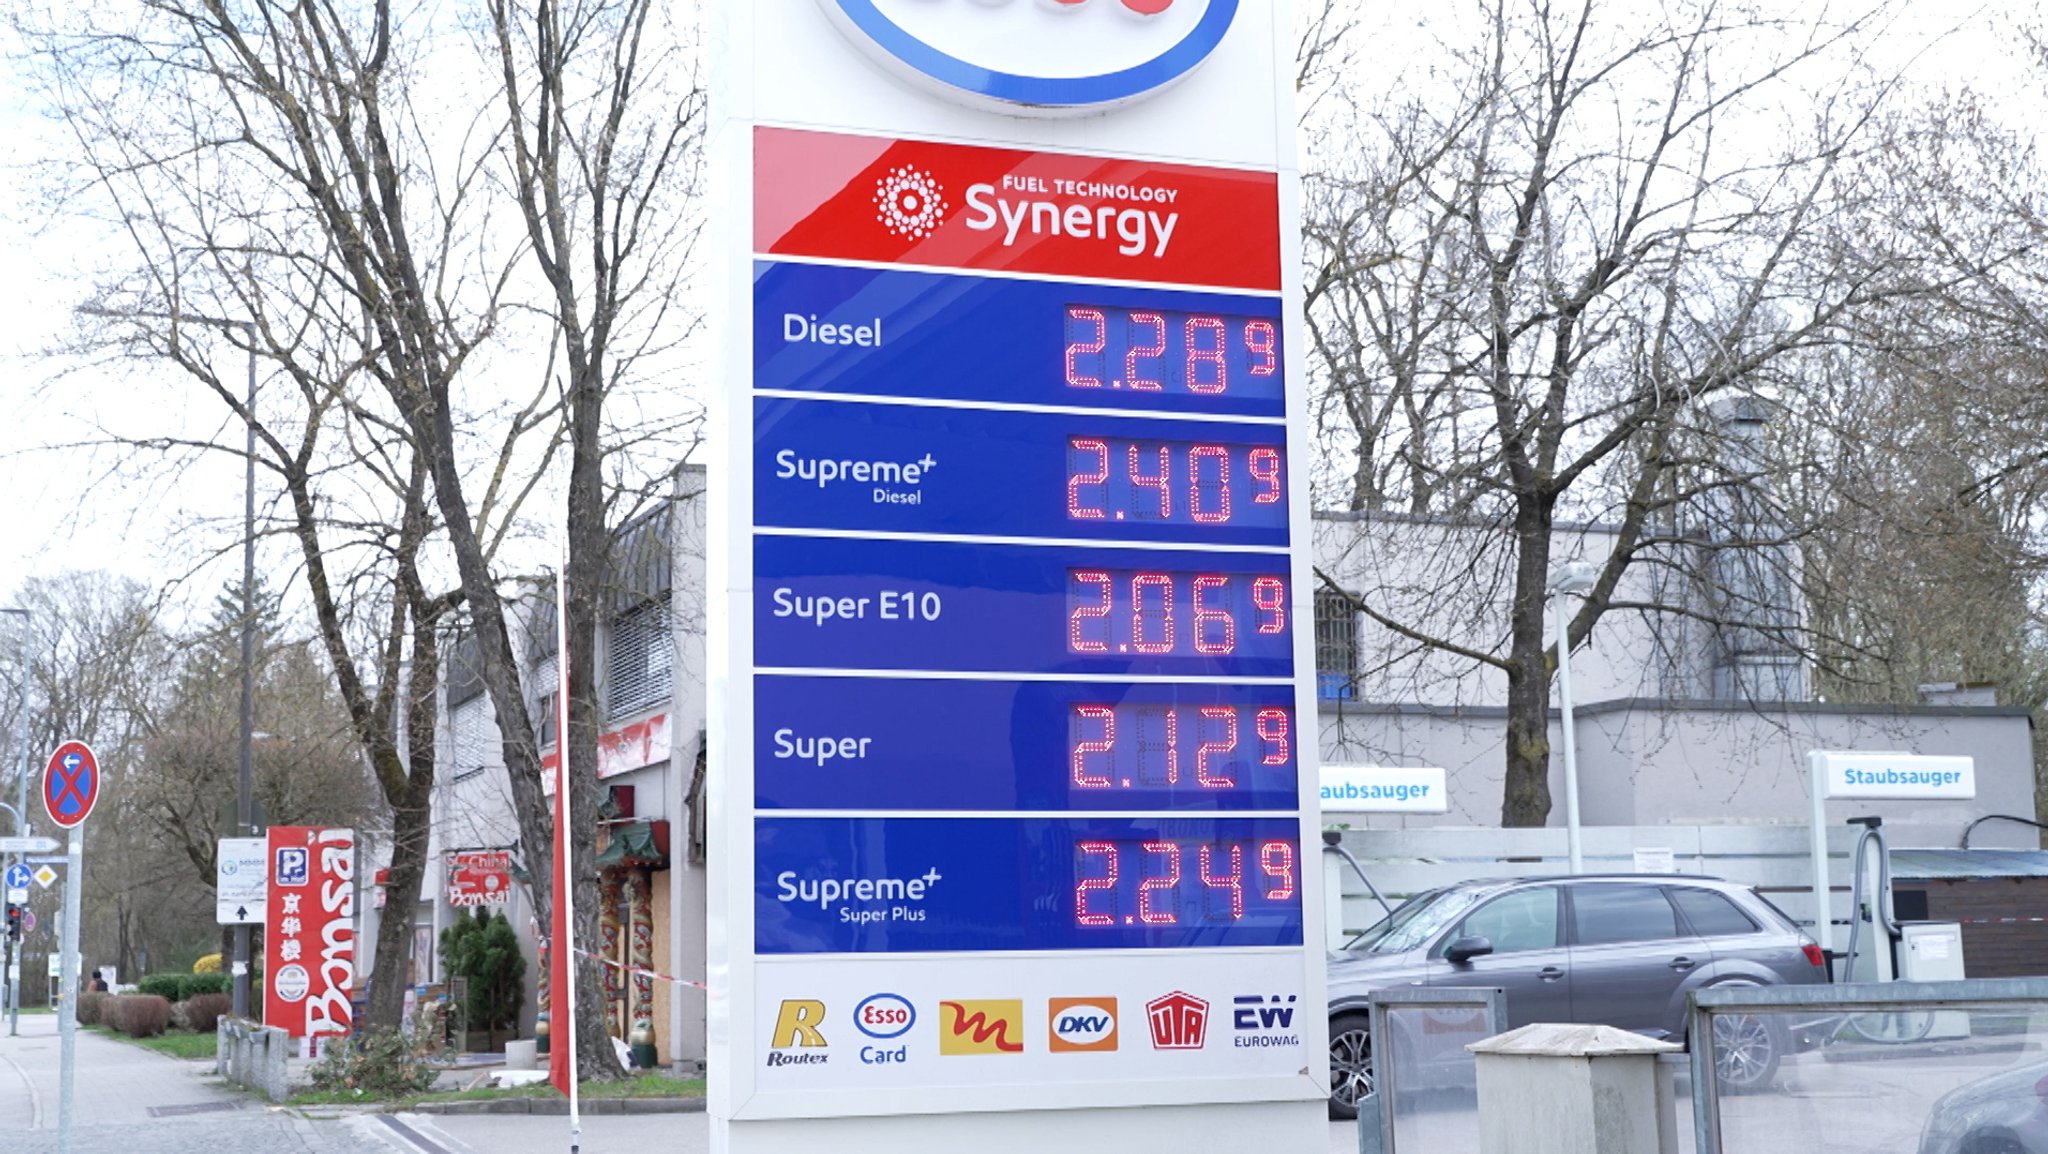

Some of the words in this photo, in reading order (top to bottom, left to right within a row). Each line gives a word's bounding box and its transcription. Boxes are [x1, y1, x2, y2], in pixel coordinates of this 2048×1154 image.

[1002, 174, 1048, 193] FUEL
[1053, 178, 1178, 203] TECHNOLOGY
[964, 182, 1179, 258] Synergy
[783, 312, 881, 347] Diesel
[872, 487, 922, 505] Diesel
[772, 587, 871, 627] Super
[879, 590, 942, 621] E10
[773, 727, 873, 767] Super
[1844, 768, 1961, 788] Staubsauger
[1319, 781, 1431, 801] aubsauger
[839, 906, 887, 927] Super
[891, 905, 926, 922] Plus
[863, 1005, 907, 1024] Esso
[1150, 996, 1205, 1045] UTA
[1233, 994, 1297, 1030] EW
[1059, 1016, 1109, 1033] DKV
[767, 1051, 828, 1067] Routex
[859, 1044, 907, 1064] Card
